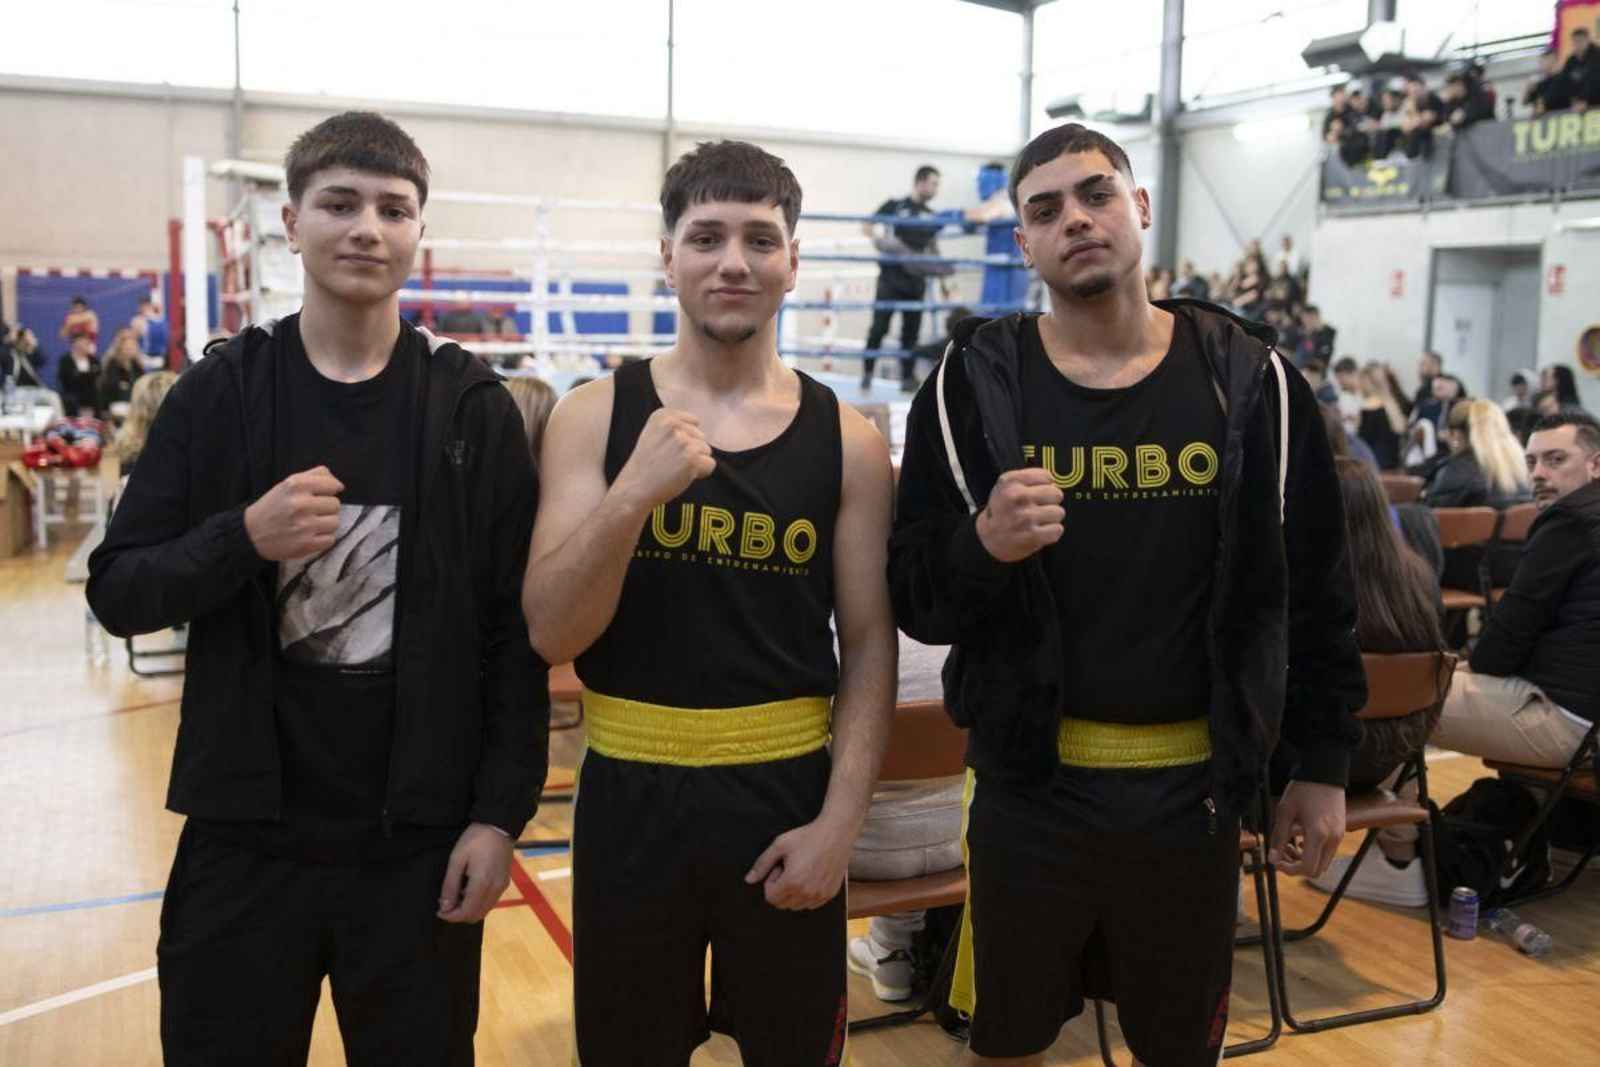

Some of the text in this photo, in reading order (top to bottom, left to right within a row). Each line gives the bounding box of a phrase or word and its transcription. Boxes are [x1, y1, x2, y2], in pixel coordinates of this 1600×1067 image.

[1514, 109, 1600, 153] TURB
[1075, 491, 1092, 500] DE
[652, 503, 817, 564] URBO
[681, 552, 697, 562] DE
